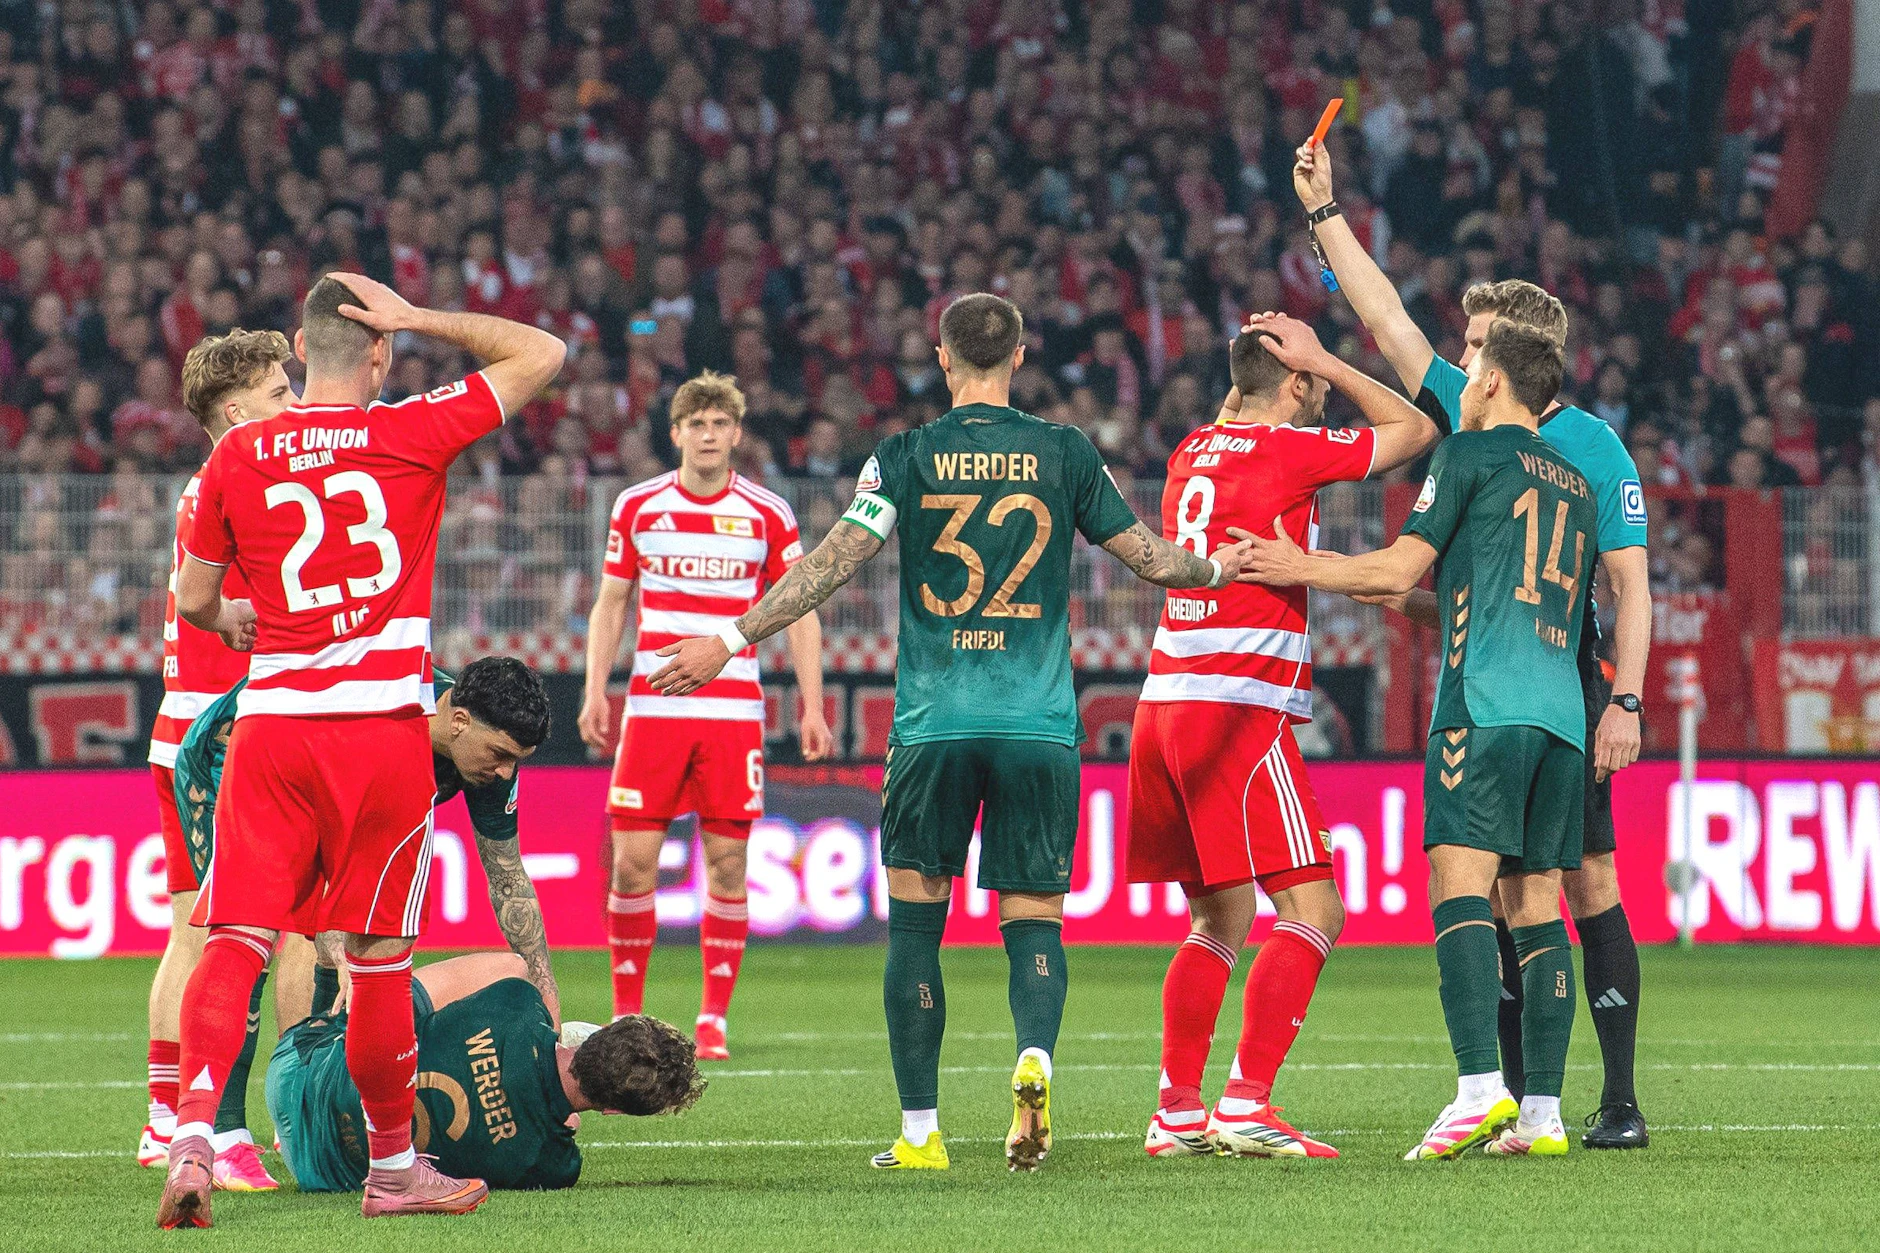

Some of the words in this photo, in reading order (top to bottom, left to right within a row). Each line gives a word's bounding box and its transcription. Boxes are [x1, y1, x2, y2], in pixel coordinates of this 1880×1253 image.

[253, 440, 269, 460] 1.
[274, 434, 297, 455] FC
[302, 426, 368, 450] UNION
[289, 449, 334, 473] BERLIN
[934, 452, 1038, 481] WERDER
[1516, 451, 1589, 500] WERDER
[1174, 475, 1215, 560] 8
[265, 470, 402, 613] 23
[919, 493, 1052, 618] 32
[1513, 487, 1585, 622] 14
[668, 552, 748, 579] raisin
[952, 629, 1006, 650] FRIEDL
[746, 748, 764, 791] 6
[465, 1027, 517, 1145] WERDER
